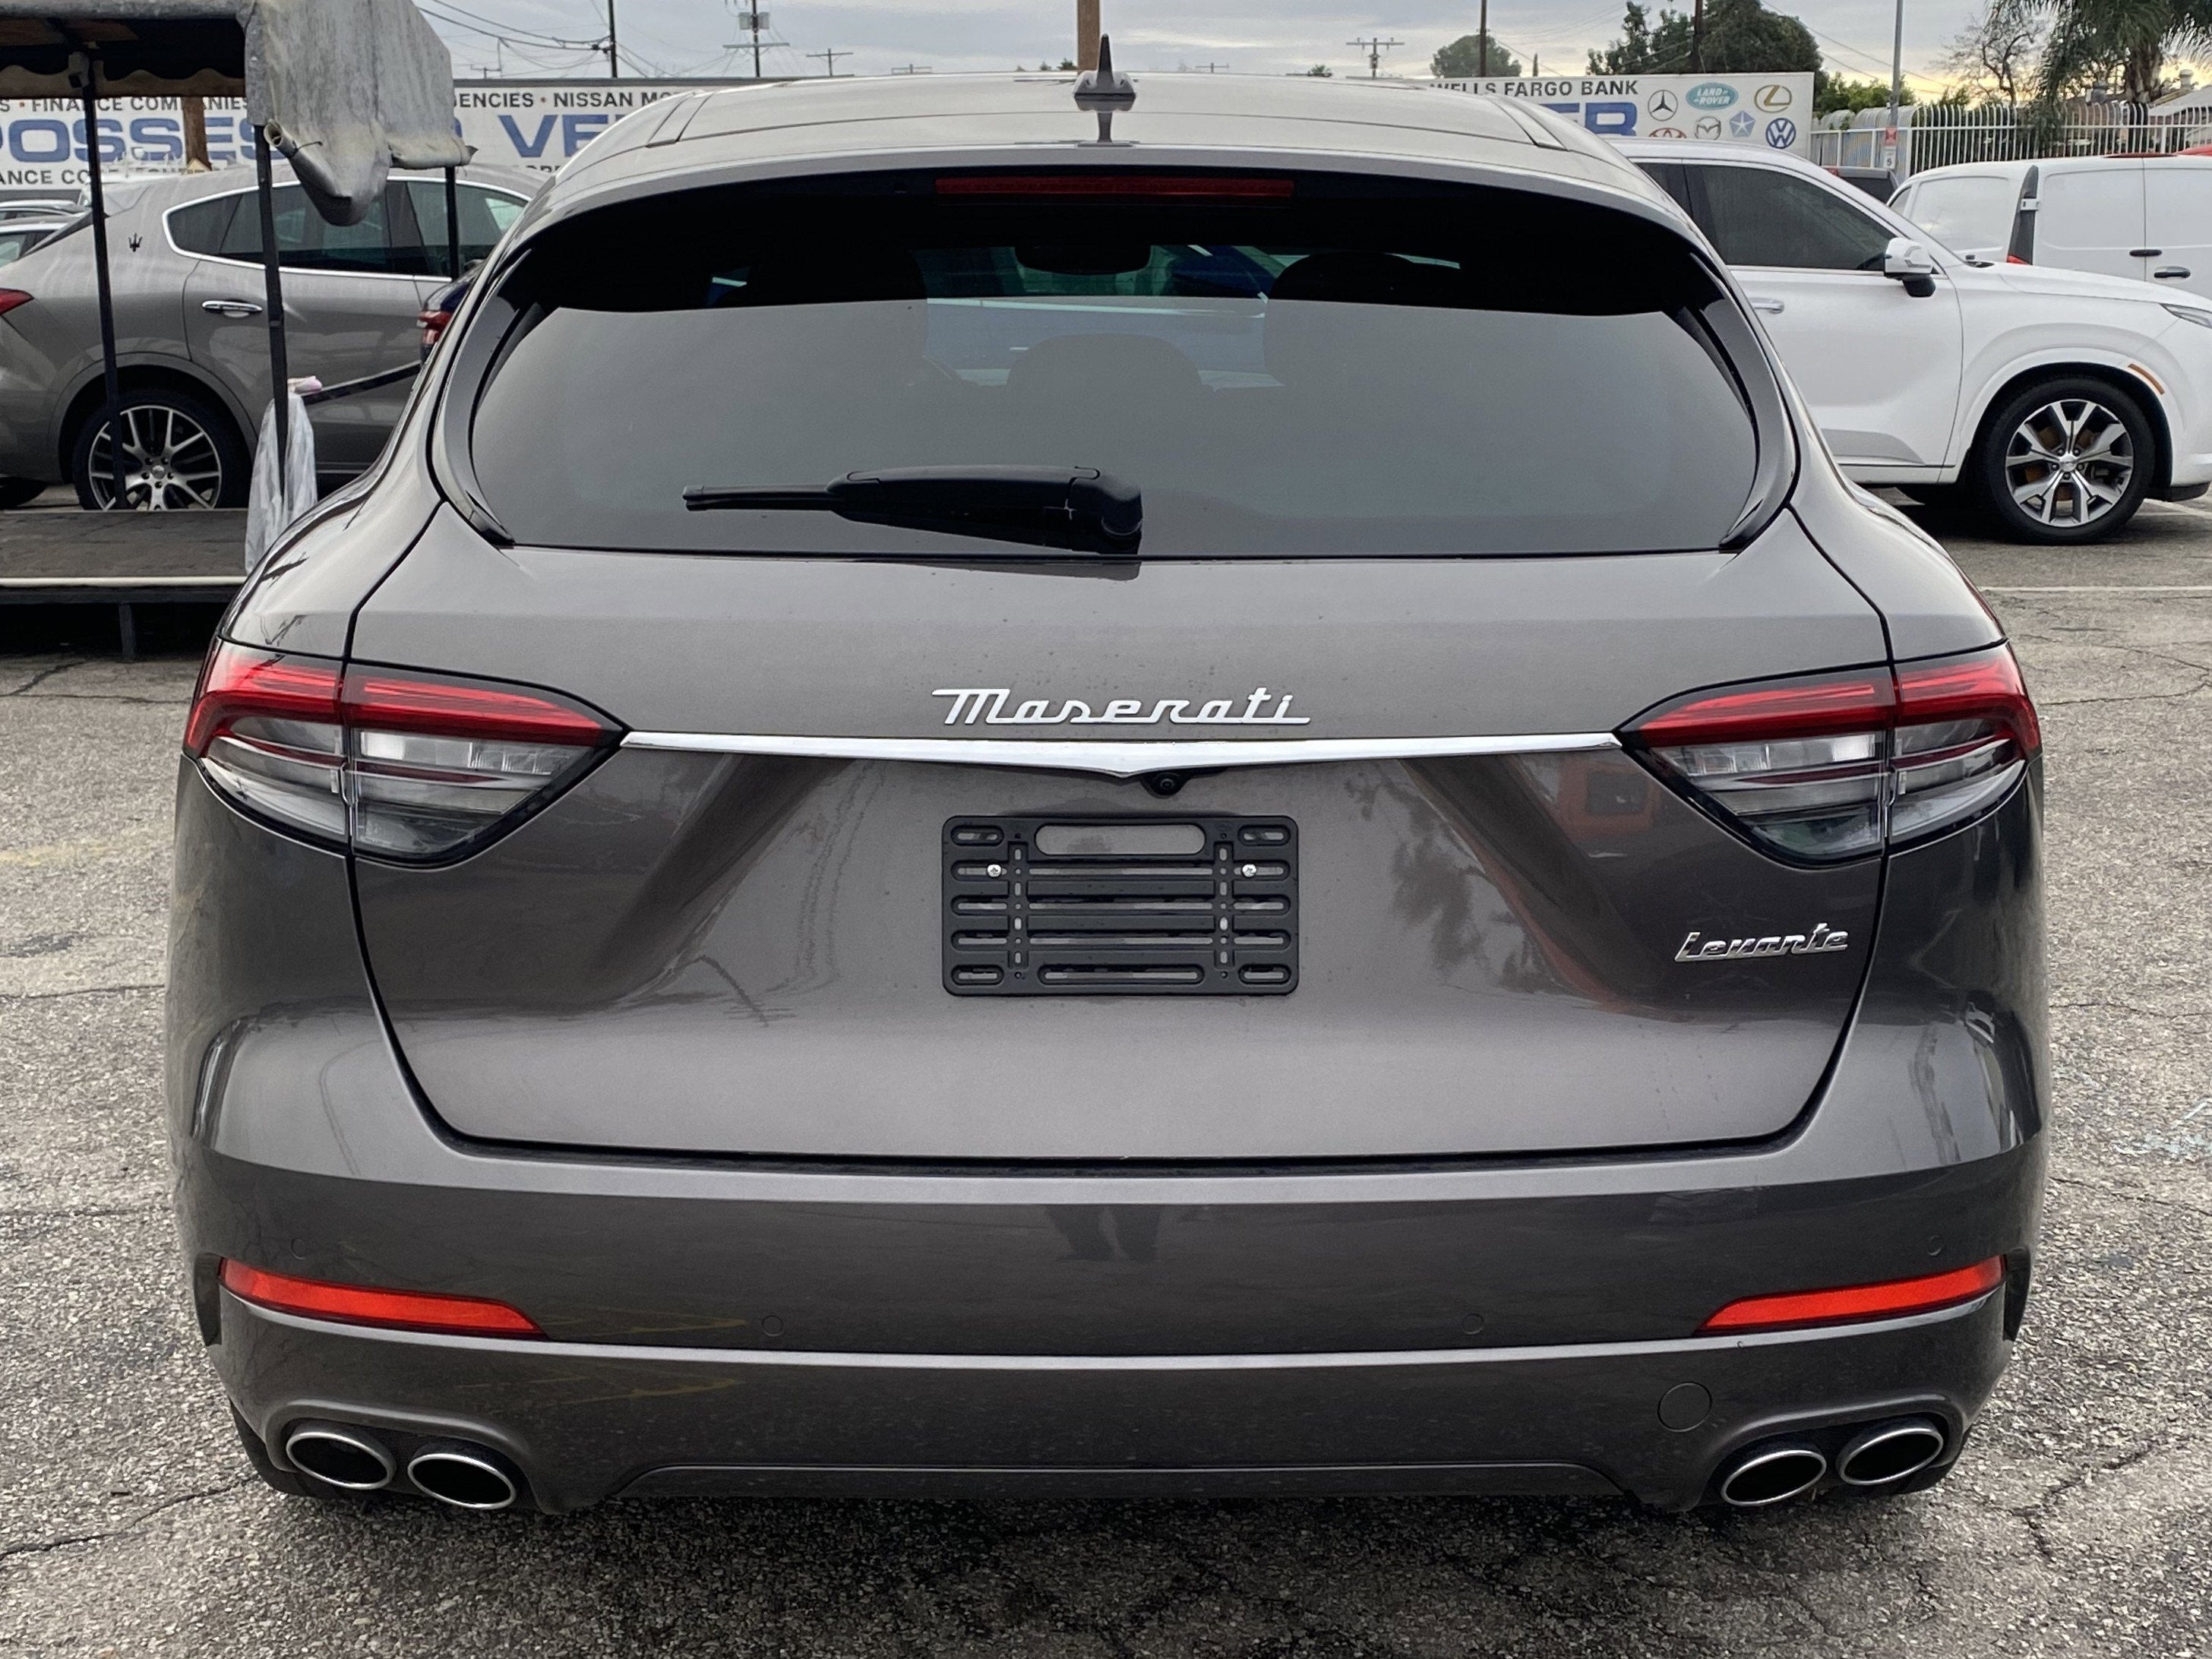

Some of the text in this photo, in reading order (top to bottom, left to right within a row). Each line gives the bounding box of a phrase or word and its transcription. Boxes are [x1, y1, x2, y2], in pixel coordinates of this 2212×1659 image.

[1505, 81, 1573, 96] FARGO
[1581, 80, 1638, 96] BANK
[1697, 87, 1723, 96] LAND
[32, 97, 122, 112] FINACE
[454, 92, 533, 108] ENCIES
[554, 90, 633, 107] NISSAN
[1698, 96, 1731, 105] ROVER
[932, 687, 1311, 725] Maserati
[1674, 922, 1849, 962] Levante
